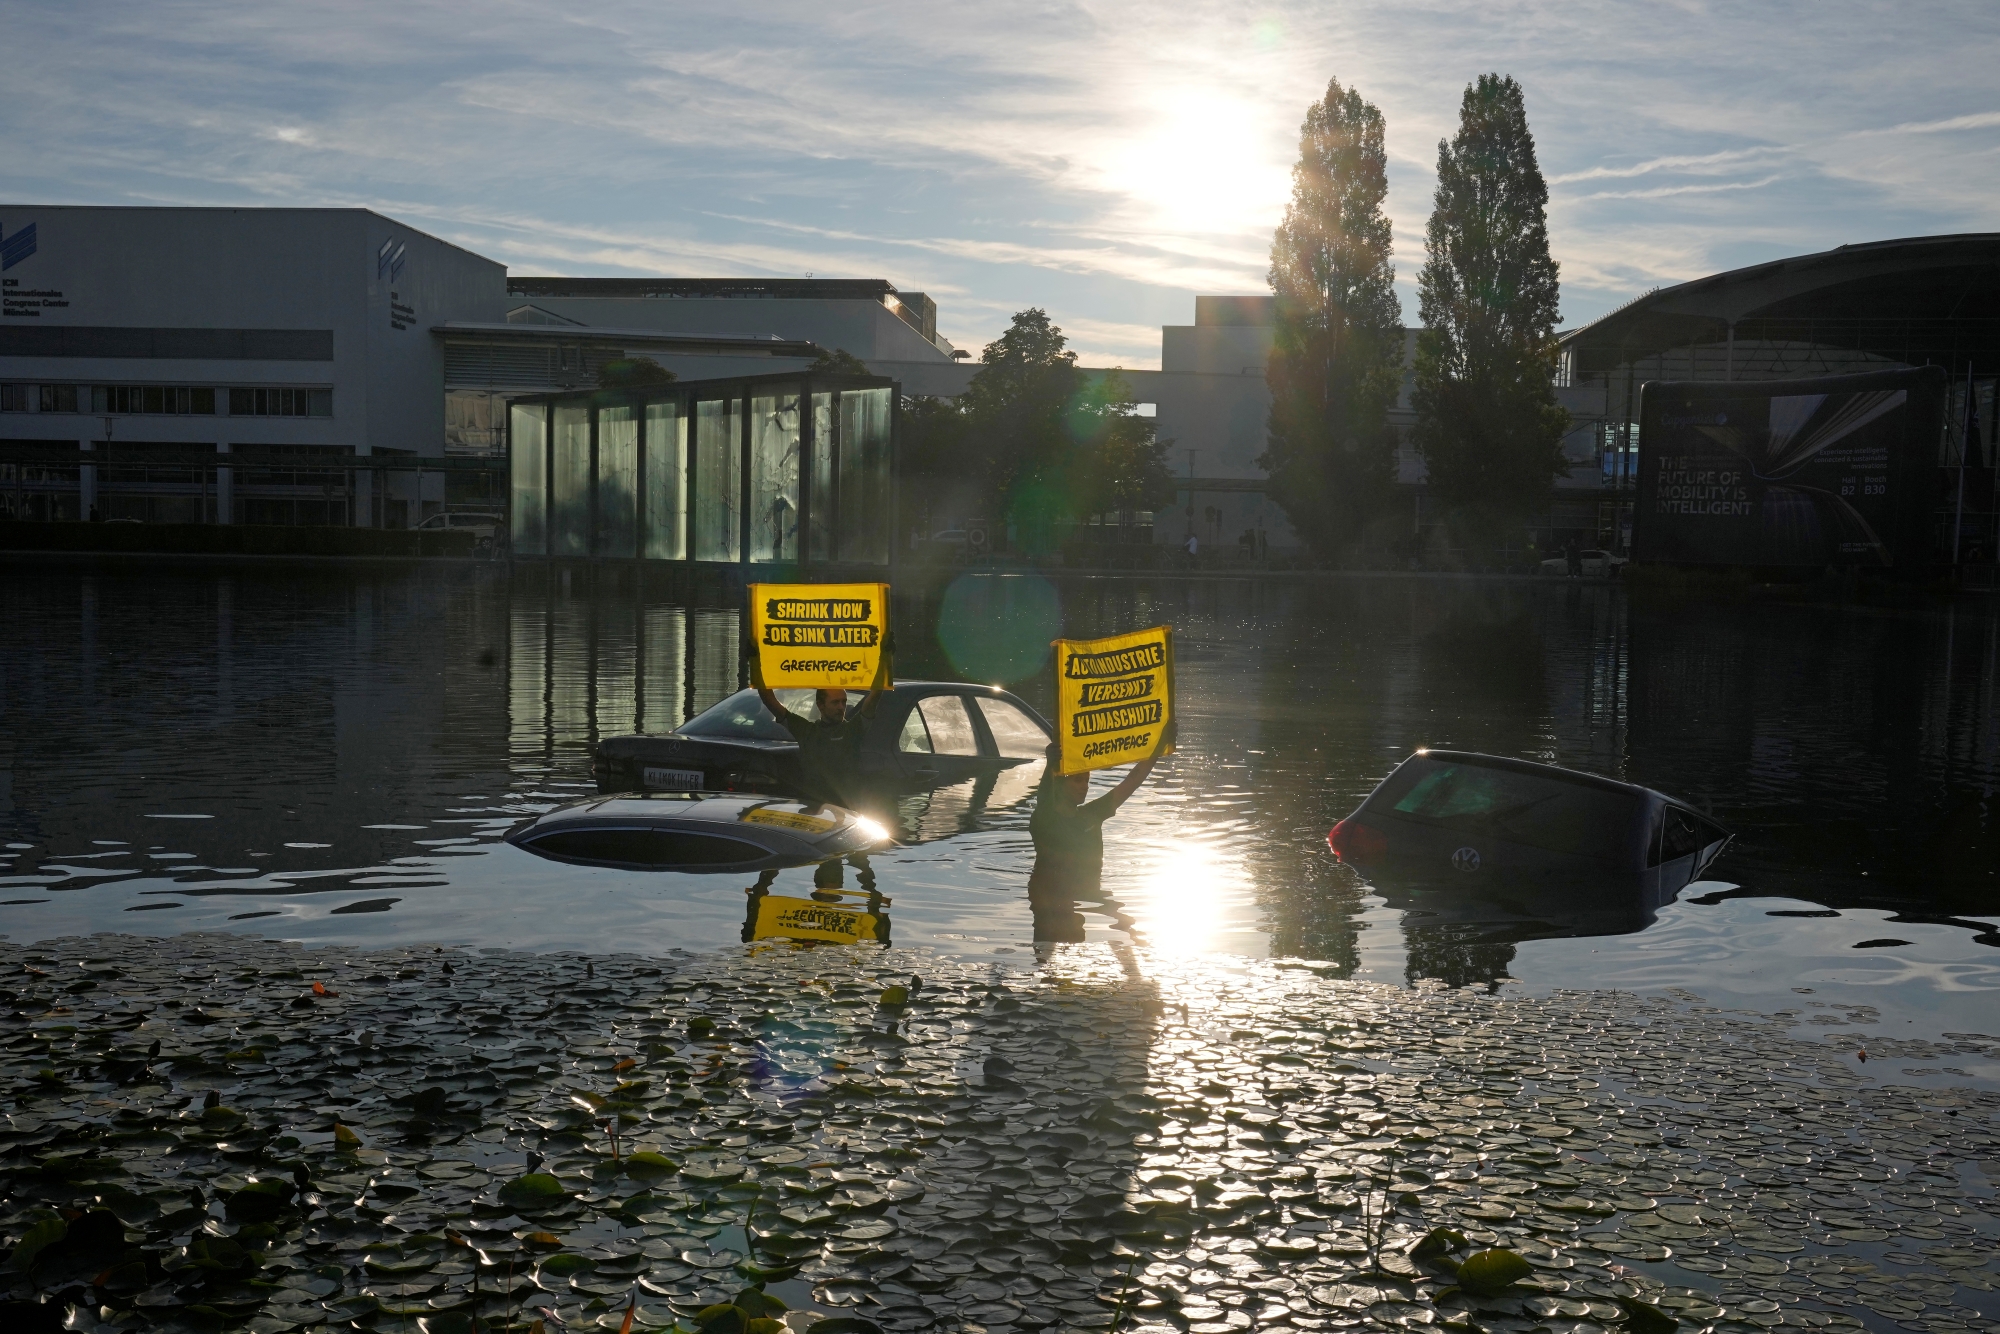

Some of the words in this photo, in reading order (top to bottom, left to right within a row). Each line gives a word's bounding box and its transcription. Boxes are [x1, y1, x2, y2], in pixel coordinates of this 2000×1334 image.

[2, 288, 63, 297] Internationales
[3, 298, 41, 308] Congress
[42, 299, 70, 307] Center
[3, 308, 41, 317] München
[1658, 456, 1688, 469] THE
[1657, 471, 1716, 484] FUTURE
[1719, 472, 1742, 485] OF
[1656, 485, 1730, 500] MOBILITY
[1733, 486, 1748, 501] IS
[1841, 486, 1856, 496] B2
[1864, 484, 1886, 495] B30
[1656, 500, 1752, 515] INTELLIGENT
[777, 602, 829, 619] SHRINK
[833, 602, 863, 619] NOW
[770, 627, 790, 643] OR
[794, 627, 826, 643] SINK
[830, 627, 871, 644] LATER
[780, 659, 861, 673] GREENPEACE
[1077, 703, 1158, 735] KLIMASCHUTZ
[1082, 732, 1151, 760] GREENPEACE
